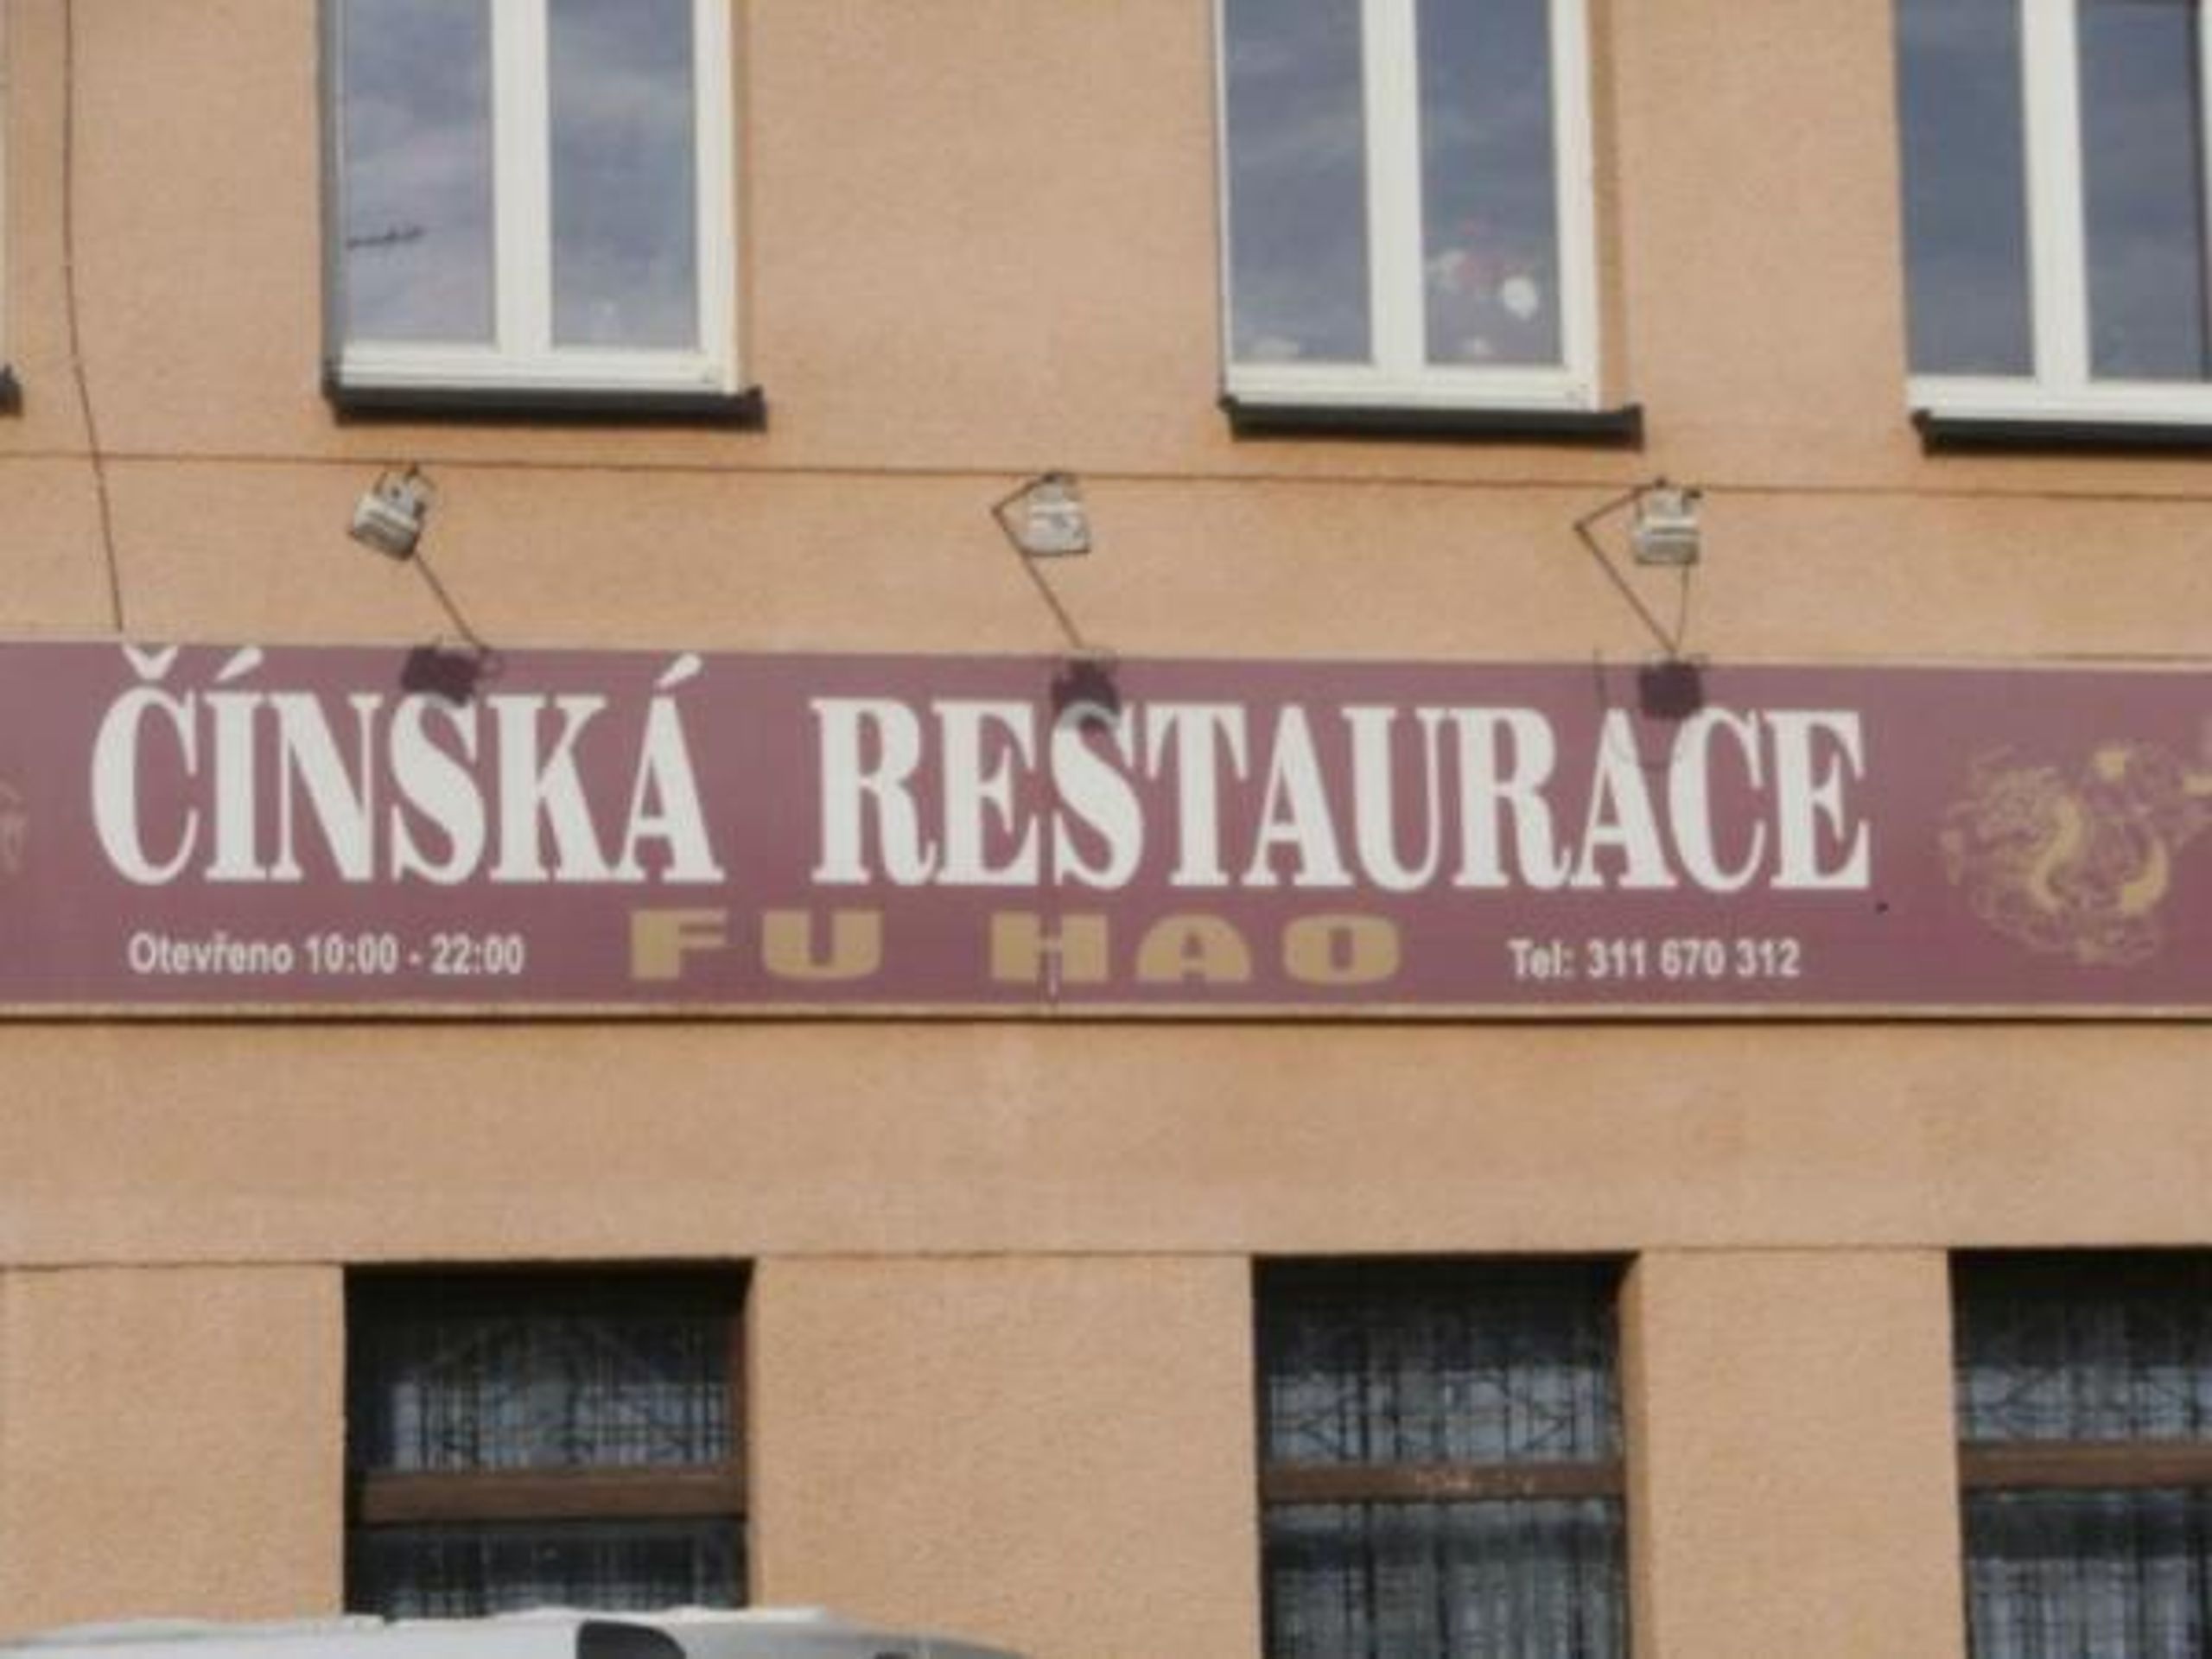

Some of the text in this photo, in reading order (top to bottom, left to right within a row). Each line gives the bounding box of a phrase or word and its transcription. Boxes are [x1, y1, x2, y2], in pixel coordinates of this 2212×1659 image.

[90, 645, 1872, 893] ČÍNSKÁ RESTAURACE
[128, 931, 294, 976] Otevřeno
[305, 932, 399, 976] 10:00
[430, 933, 525, 976] 22:00
[630, 909, 1402, 985] FU HAO
[1509, 938, 1801, 979] Tel: 311 670 312
